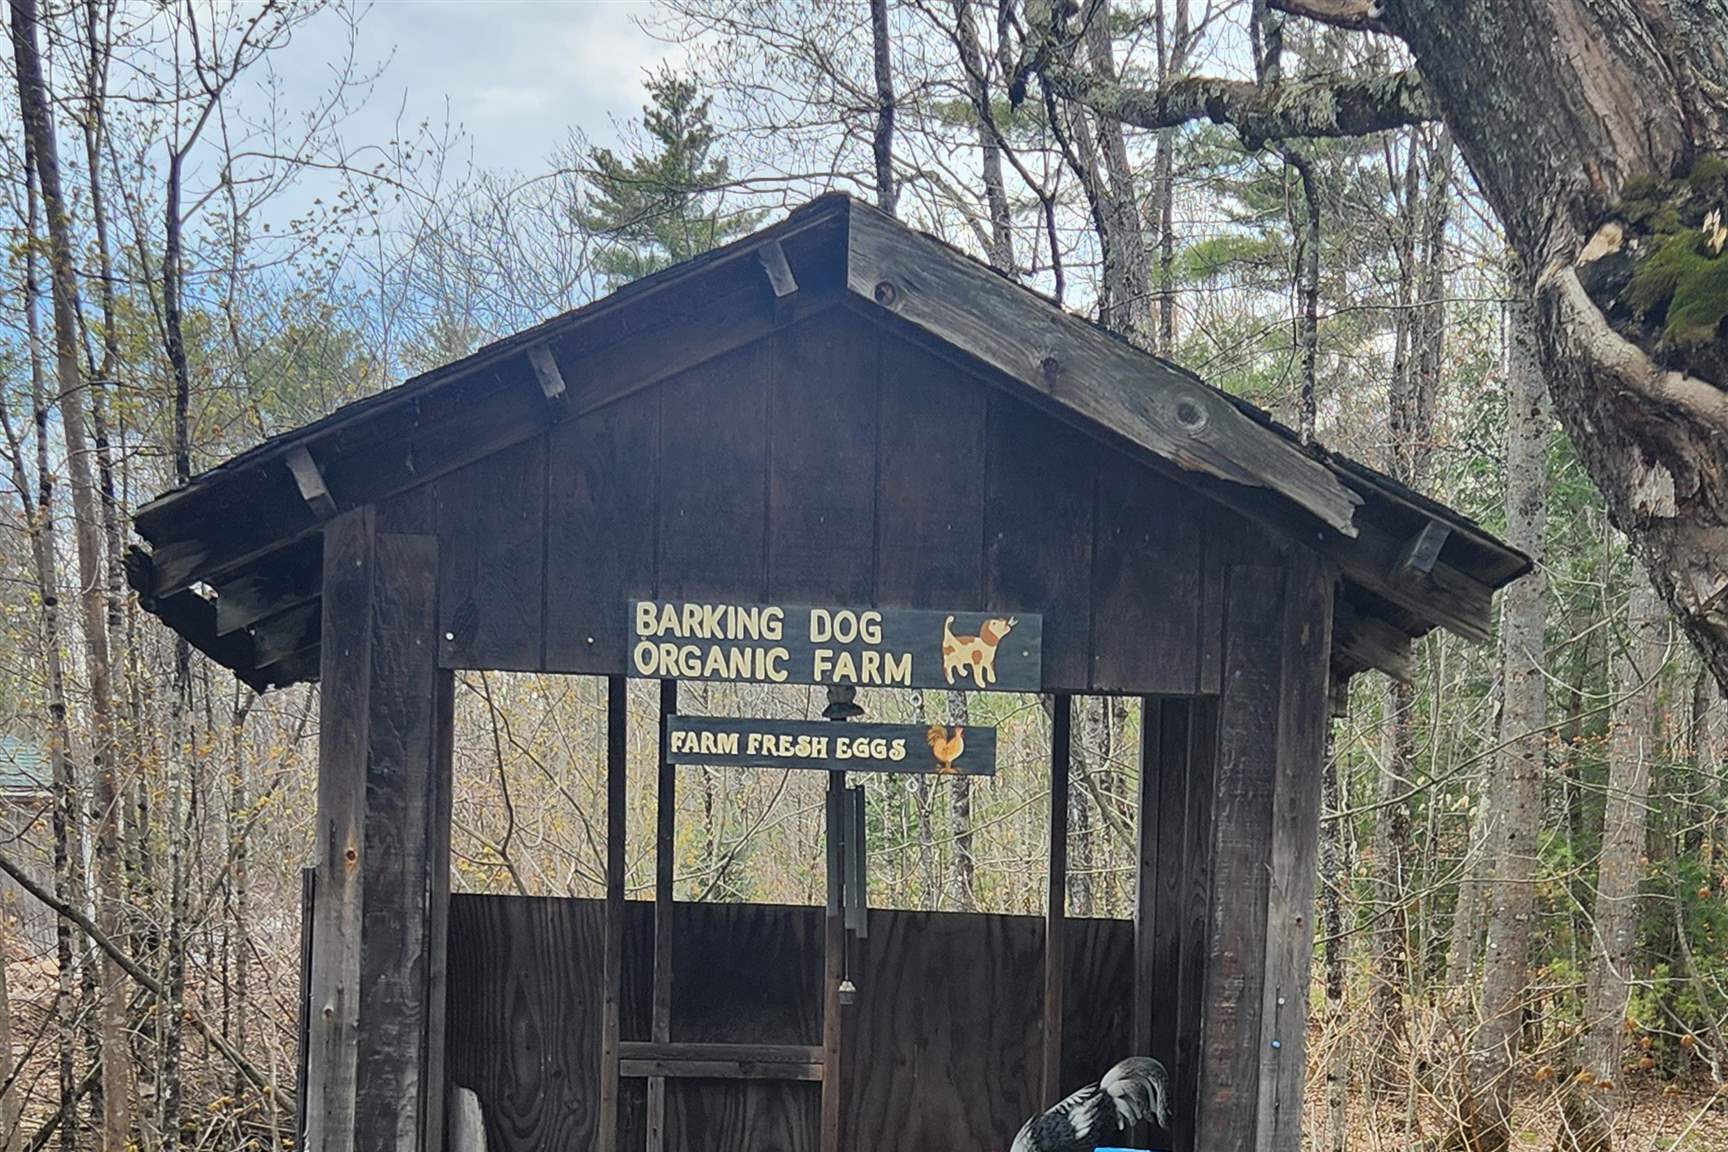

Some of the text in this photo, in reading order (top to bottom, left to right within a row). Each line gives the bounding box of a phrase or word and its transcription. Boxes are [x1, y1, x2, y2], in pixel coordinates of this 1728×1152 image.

[635, 601, 883, 644] BARKING DOG
[634, 641, 912, 686] ORGANIC FARM
[670, 730, 907, 760] FARM FRESH EGGS
